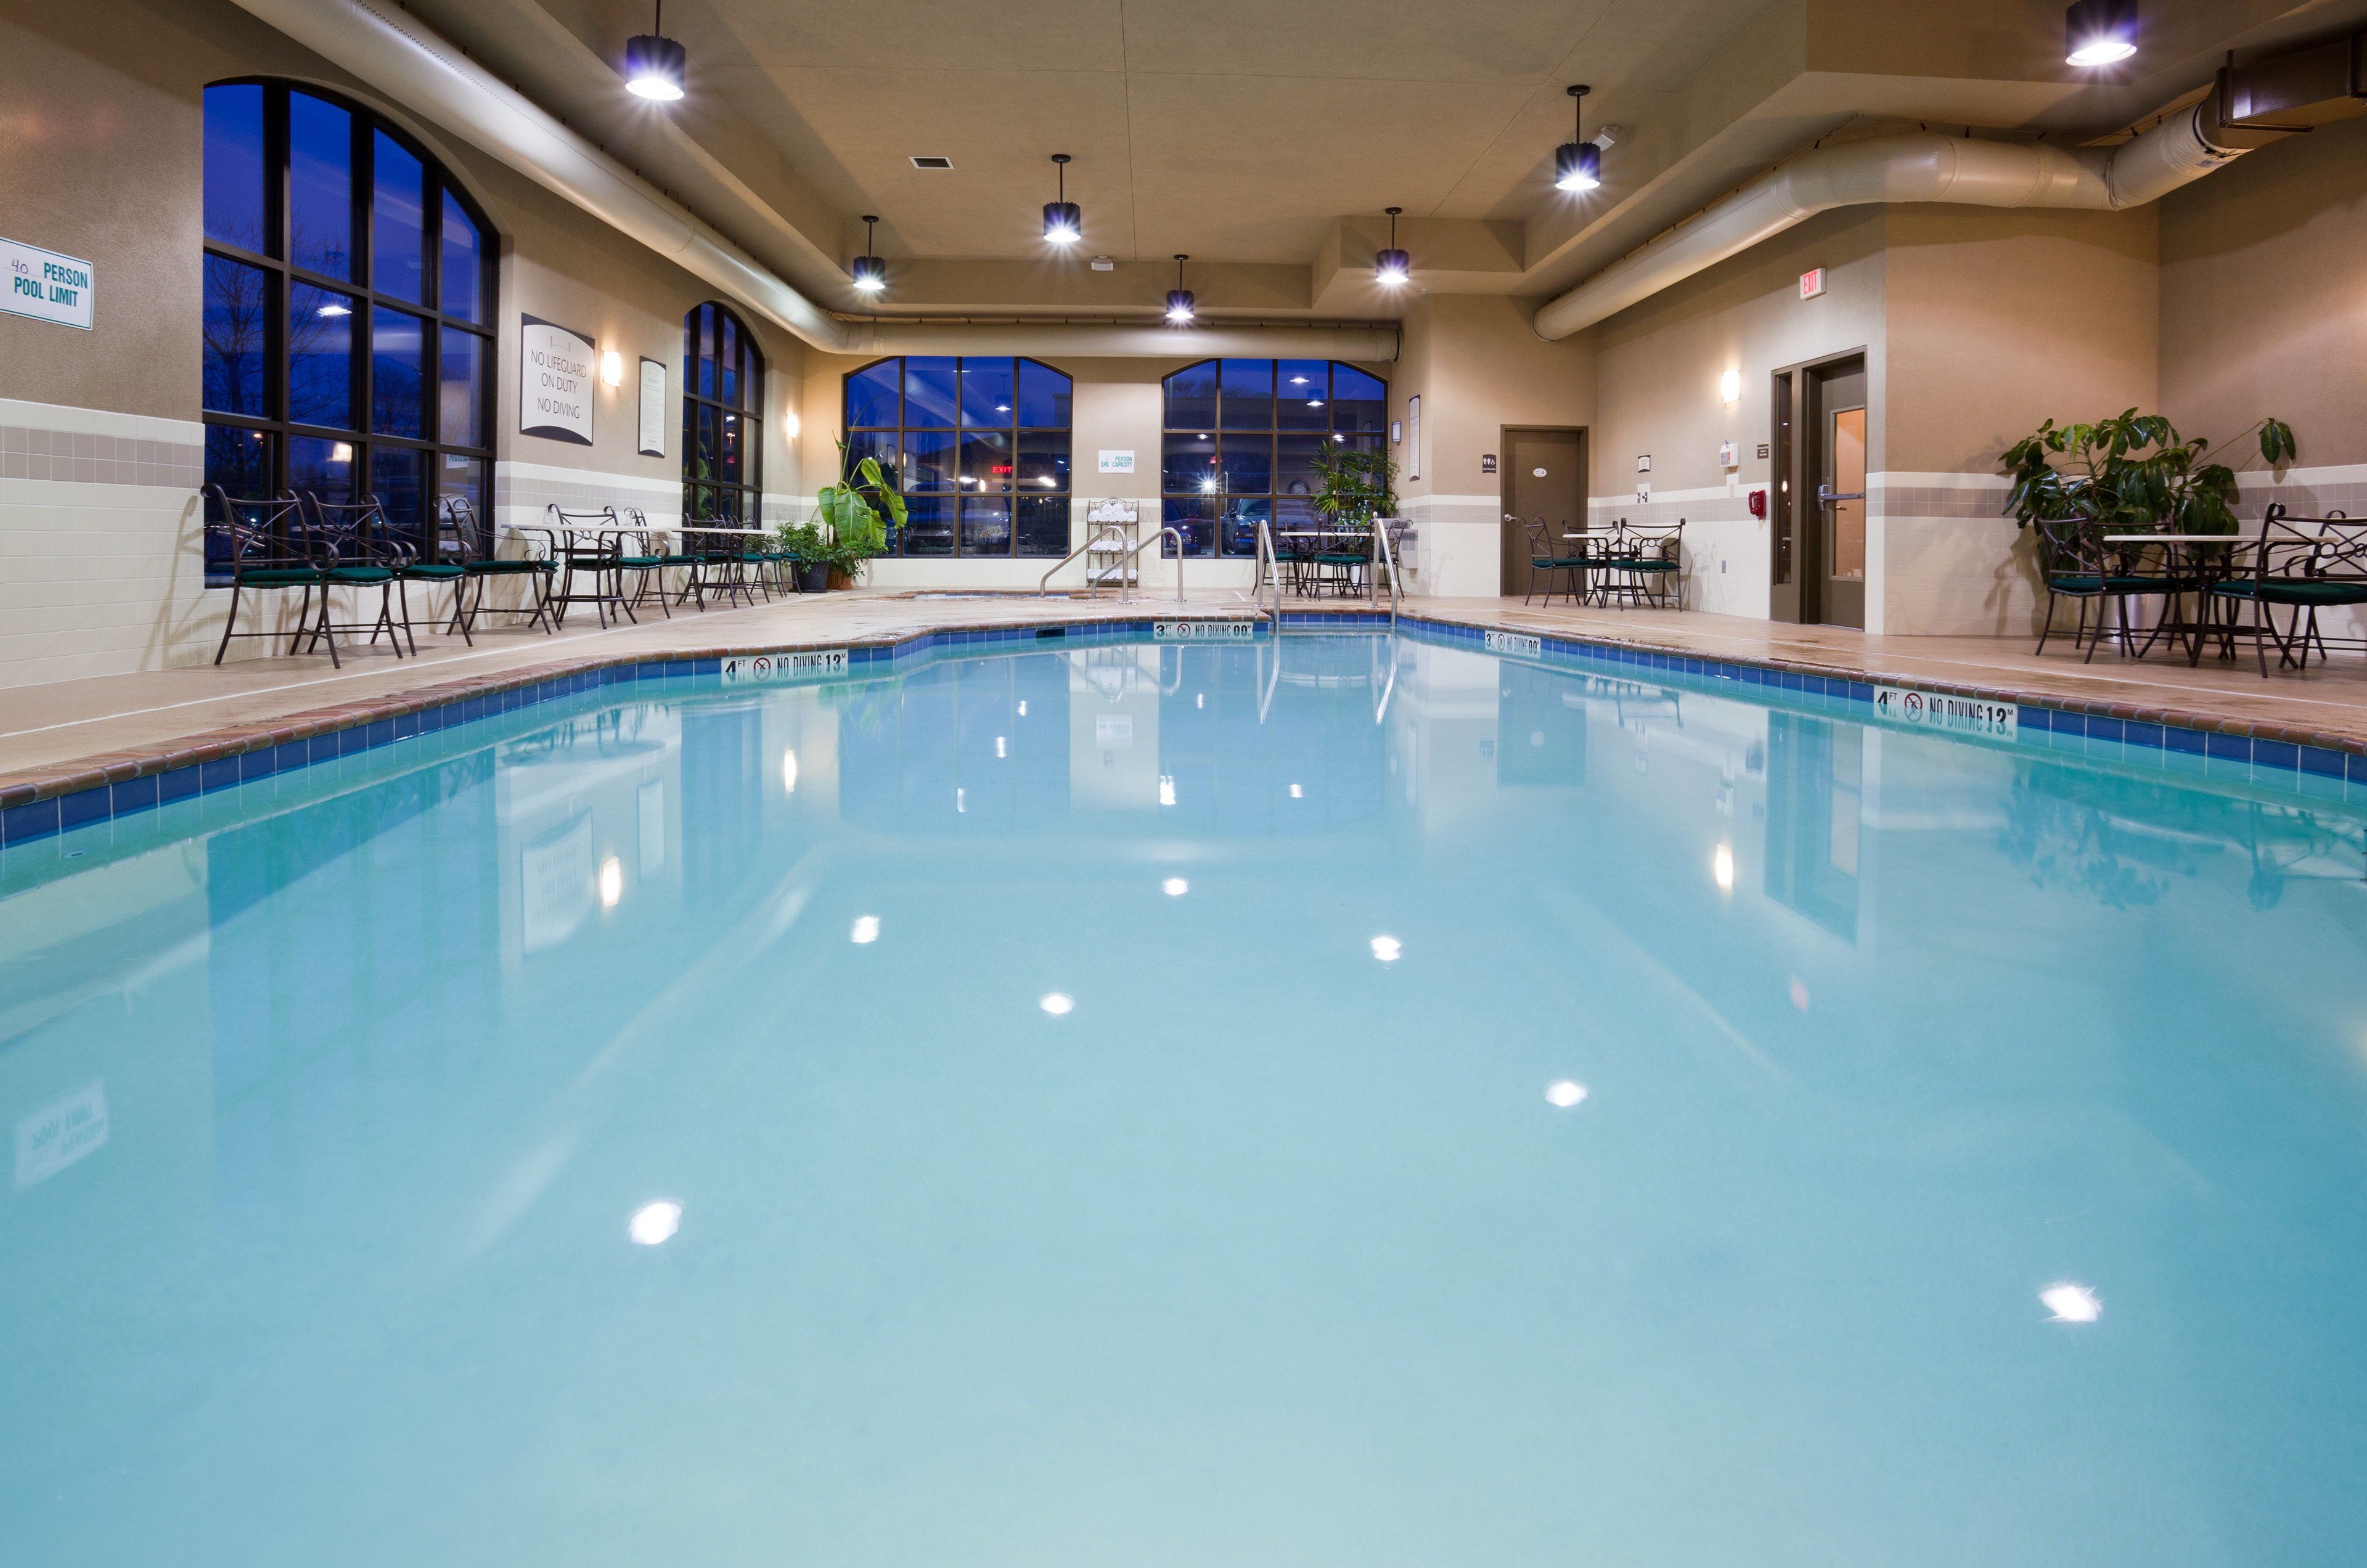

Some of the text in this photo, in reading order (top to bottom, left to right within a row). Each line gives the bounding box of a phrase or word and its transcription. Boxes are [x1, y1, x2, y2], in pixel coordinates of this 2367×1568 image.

[11, 258, 88, 289] 40 PERSON
[1803, 270, 1818, 295] EXIT
[14, 276, 78, 307] POOL LIMIT
[531, 349, 587, 378] NO LIFEGUARD
[541, 372, 578, 394] ON DUTY
[538, 397, 580, 419] NO DIVING
[992, 465, 1012, 473] EXIT
[777, 657, 789, 669] NO
[793, 655, 822, 668] DIVING
[1889, 692, 1897, 700] FT
[1930, 697, 1943, 713] NO
[1948, 700, 1983, 721] DIVING
